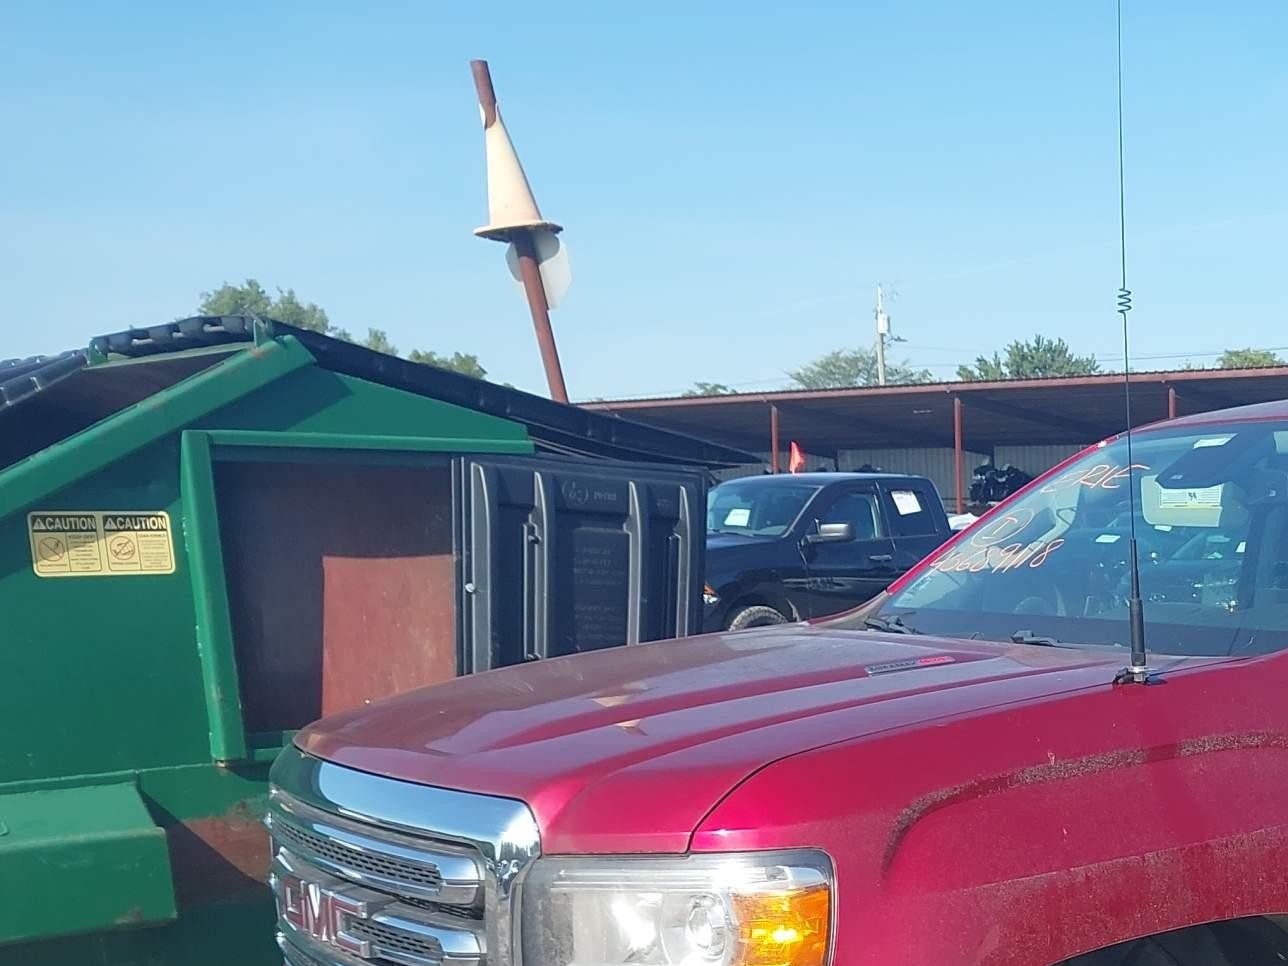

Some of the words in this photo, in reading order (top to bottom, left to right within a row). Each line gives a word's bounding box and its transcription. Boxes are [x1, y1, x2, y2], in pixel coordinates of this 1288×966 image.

[45, 517, 96, 530] CAUTION
[116, 517, 167, 530] CAUTION
[283, 880, 368, 958] GMC
